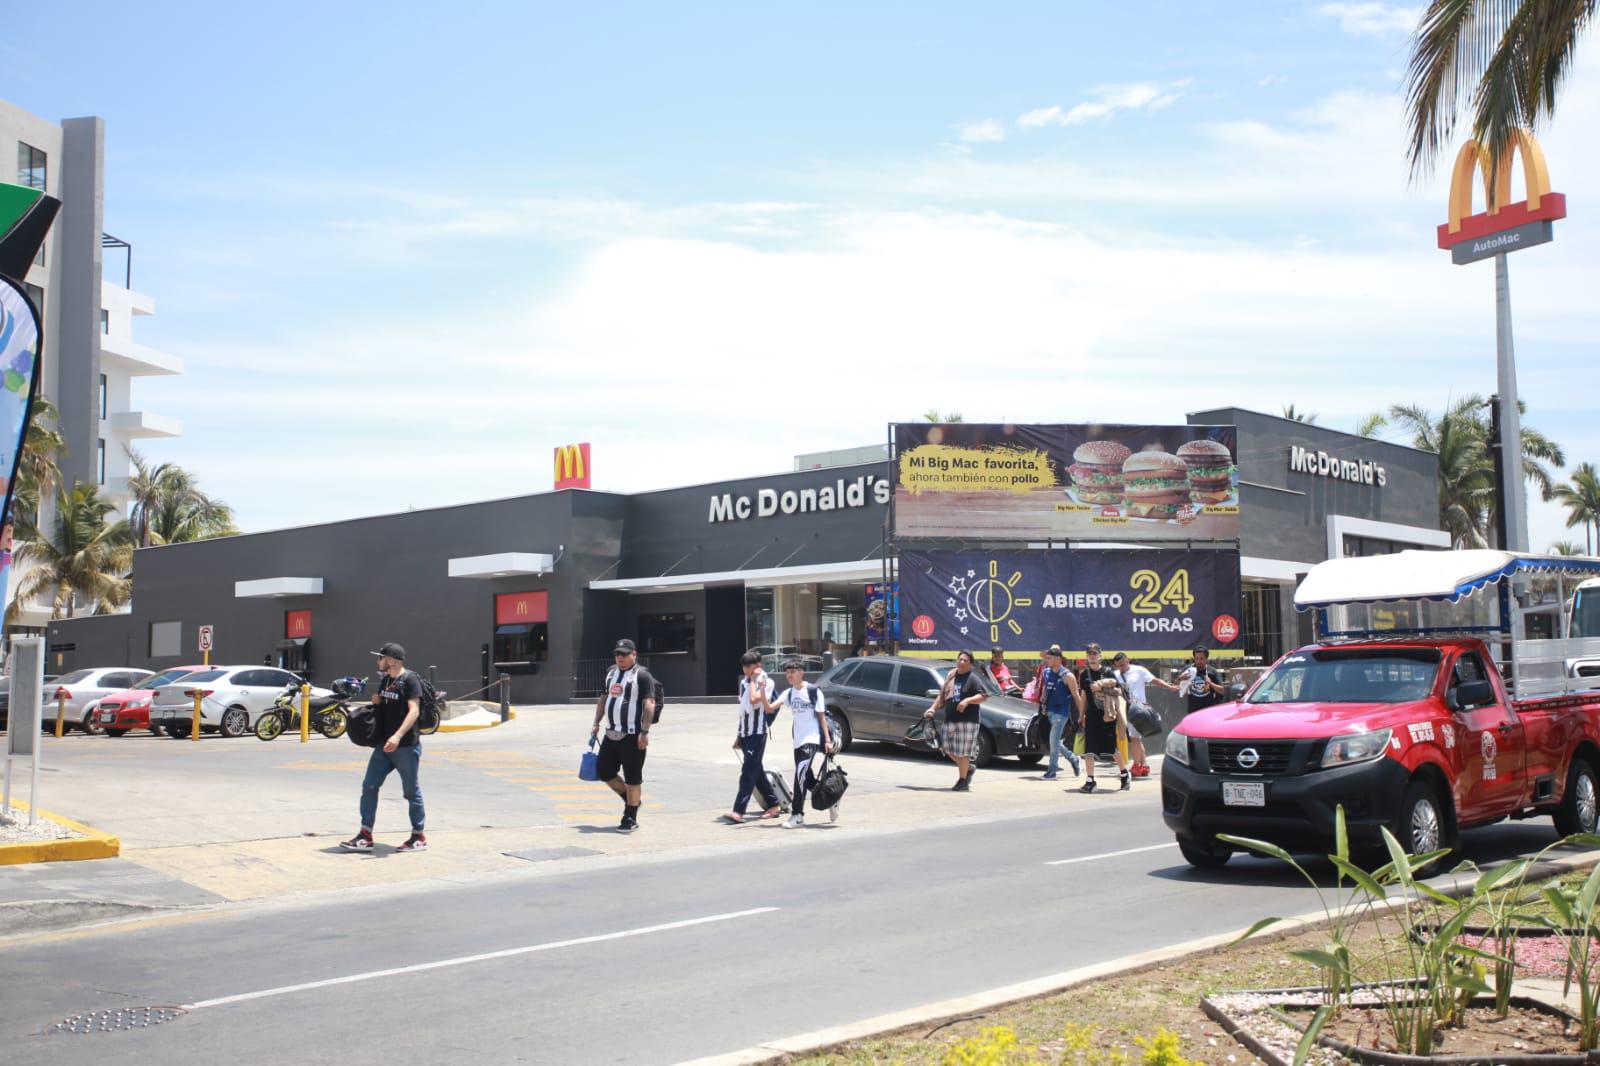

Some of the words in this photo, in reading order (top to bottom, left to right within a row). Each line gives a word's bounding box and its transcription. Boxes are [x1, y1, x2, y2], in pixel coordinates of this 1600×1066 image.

[1473, 233, 1520, 253] AutoMac
[909, 457, 925, 468] Mi
[928, 457, 949, 471] Big
[952, 458, 979, 469] Mac
[984, 457, 1039, 471] favorita,
[1291, 446, 1386, 487] McDonald's
[909, 472, 939, 482] ahora
[942, 472, 986, 483] también
[988, 475, 1009, 483] con
[1011, 474, 1039, 485] pollo
[1042, 593, 1123, 609] ABIERTO
[1130, 568, 1195, 614] 24
[1132, 617, 1194, 633] HORAS
[908, 637, 938, 646] McDelivery
